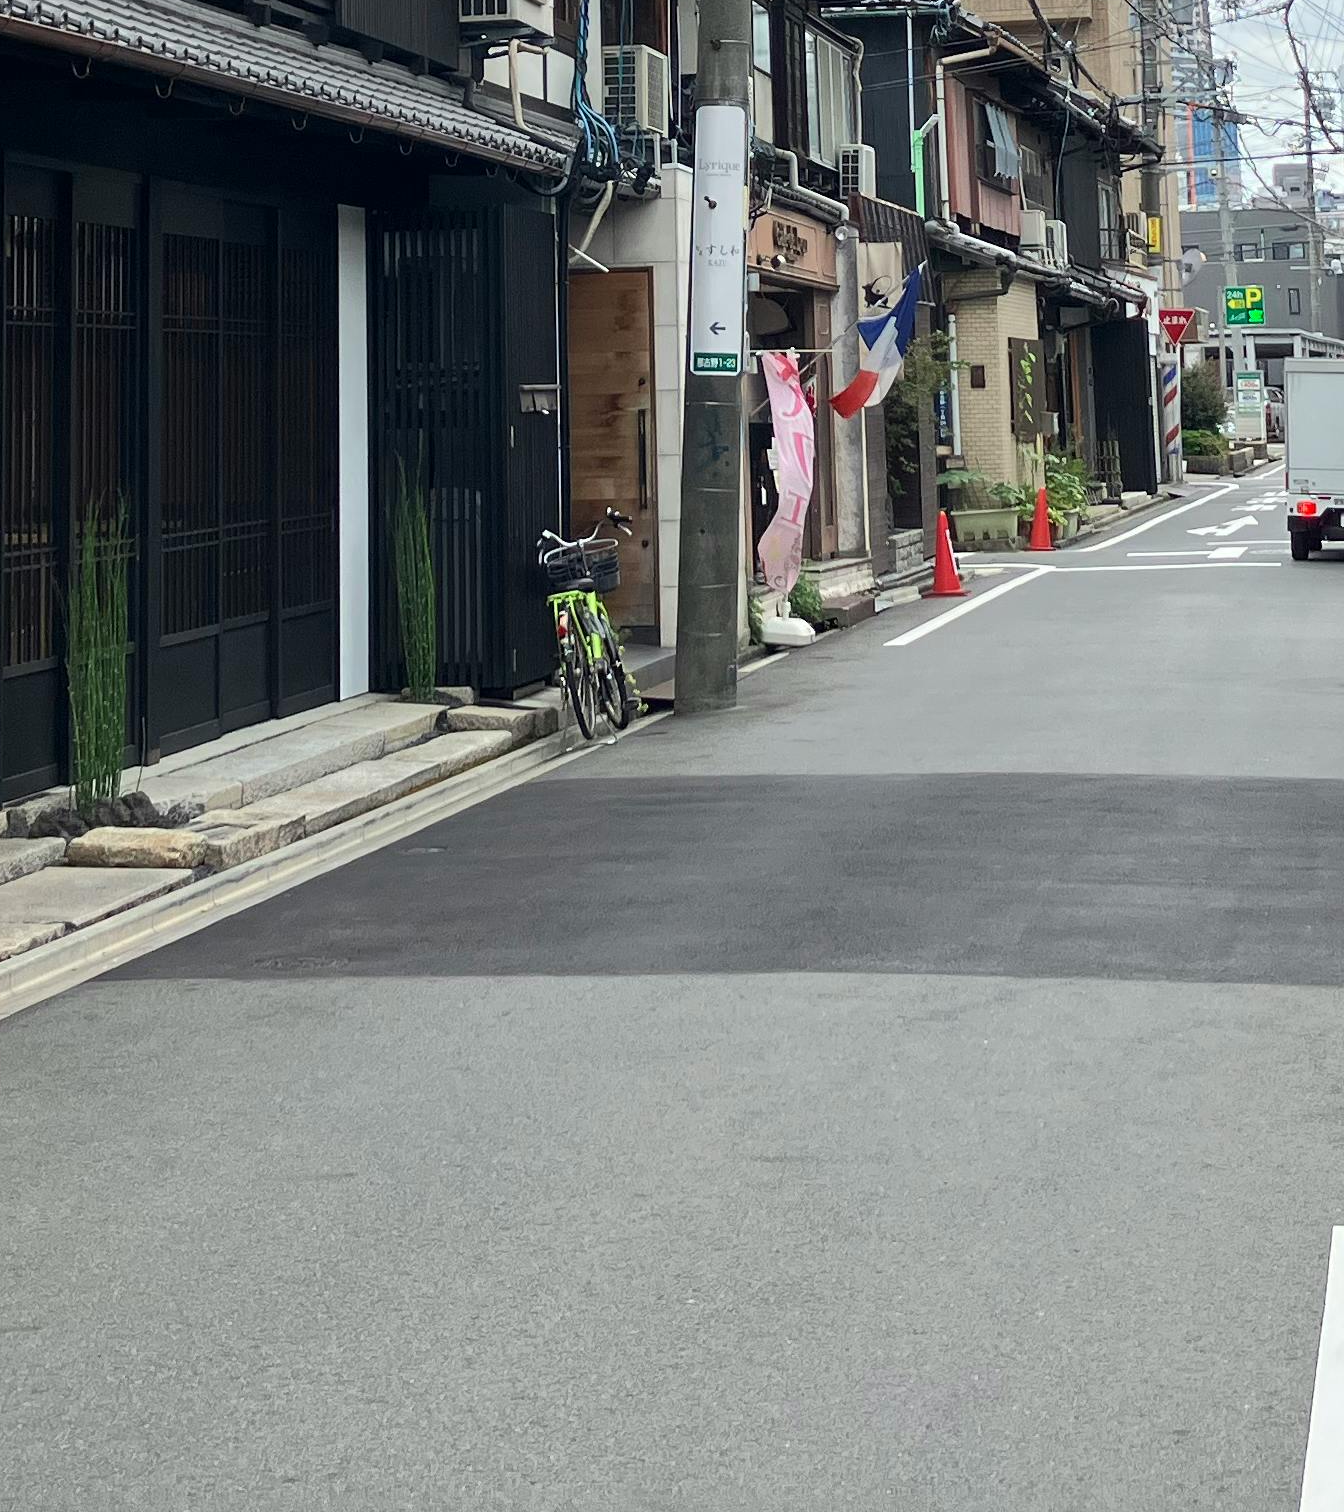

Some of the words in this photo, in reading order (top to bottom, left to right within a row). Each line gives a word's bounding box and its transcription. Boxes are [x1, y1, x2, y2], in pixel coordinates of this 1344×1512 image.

[697, 158, 741, 174] Lyrique
[1226, 290, 1244, 299] 24h
[1246, 288, 1262, 308] P
